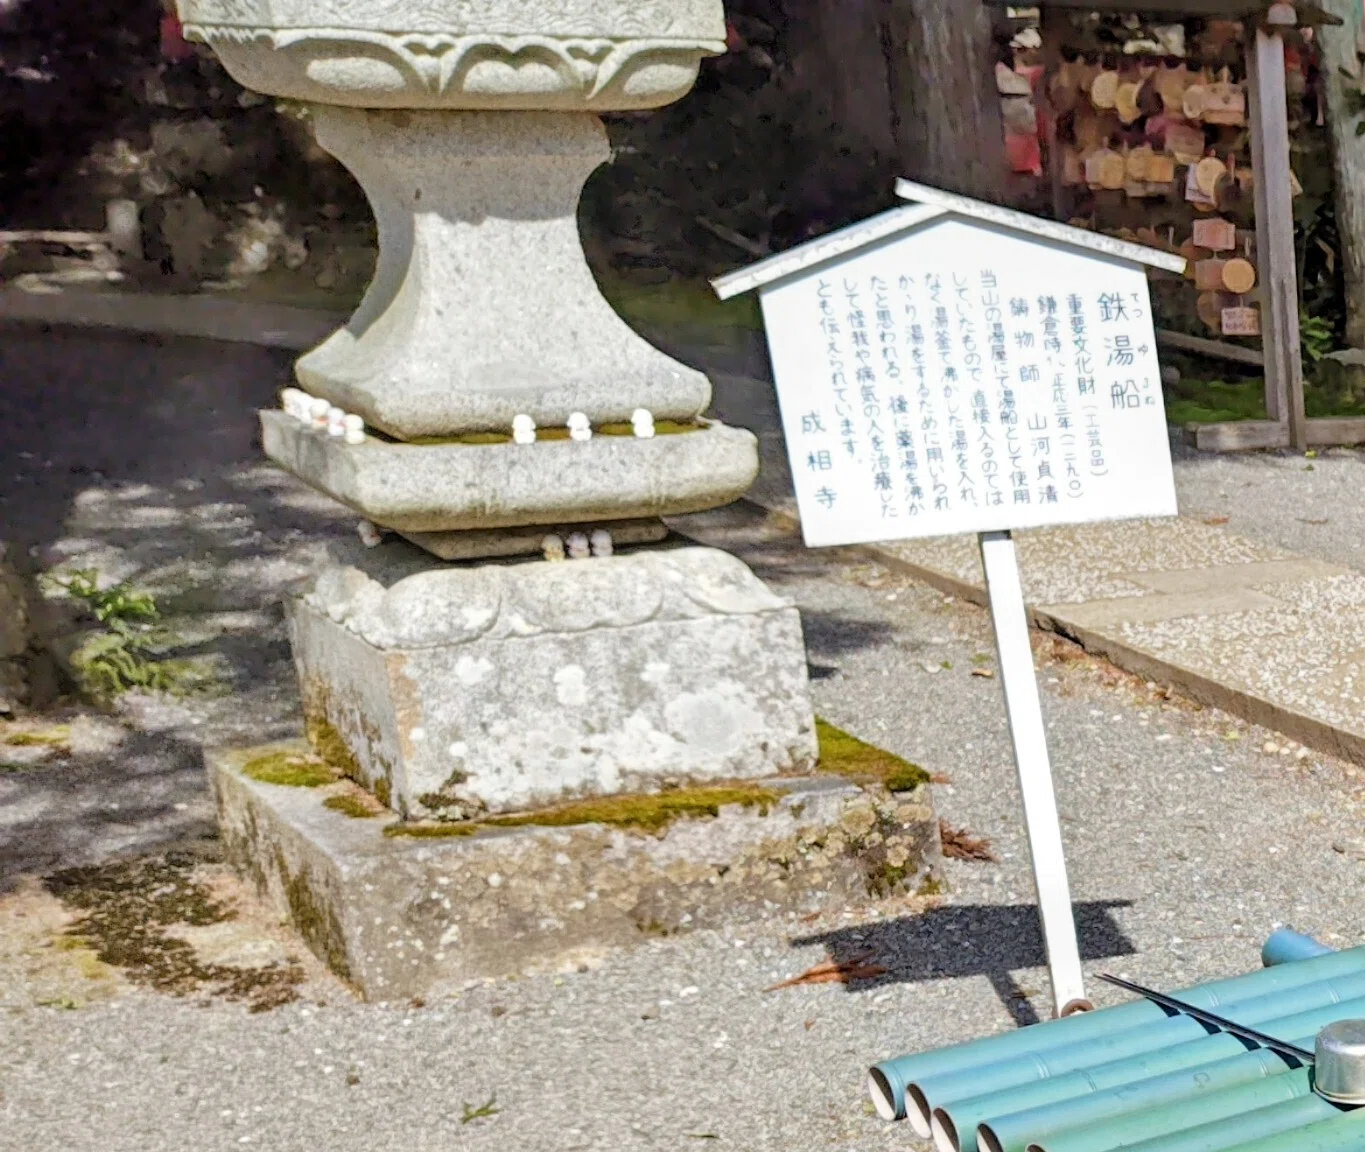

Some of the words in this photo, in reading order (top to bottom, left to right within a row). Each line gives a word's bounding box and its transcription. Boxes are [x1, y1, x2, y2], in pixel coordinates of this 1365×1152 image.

[1097, 292, 1142, 409] 鉄湯船
[801, 411, 838, 510] 成相寺
